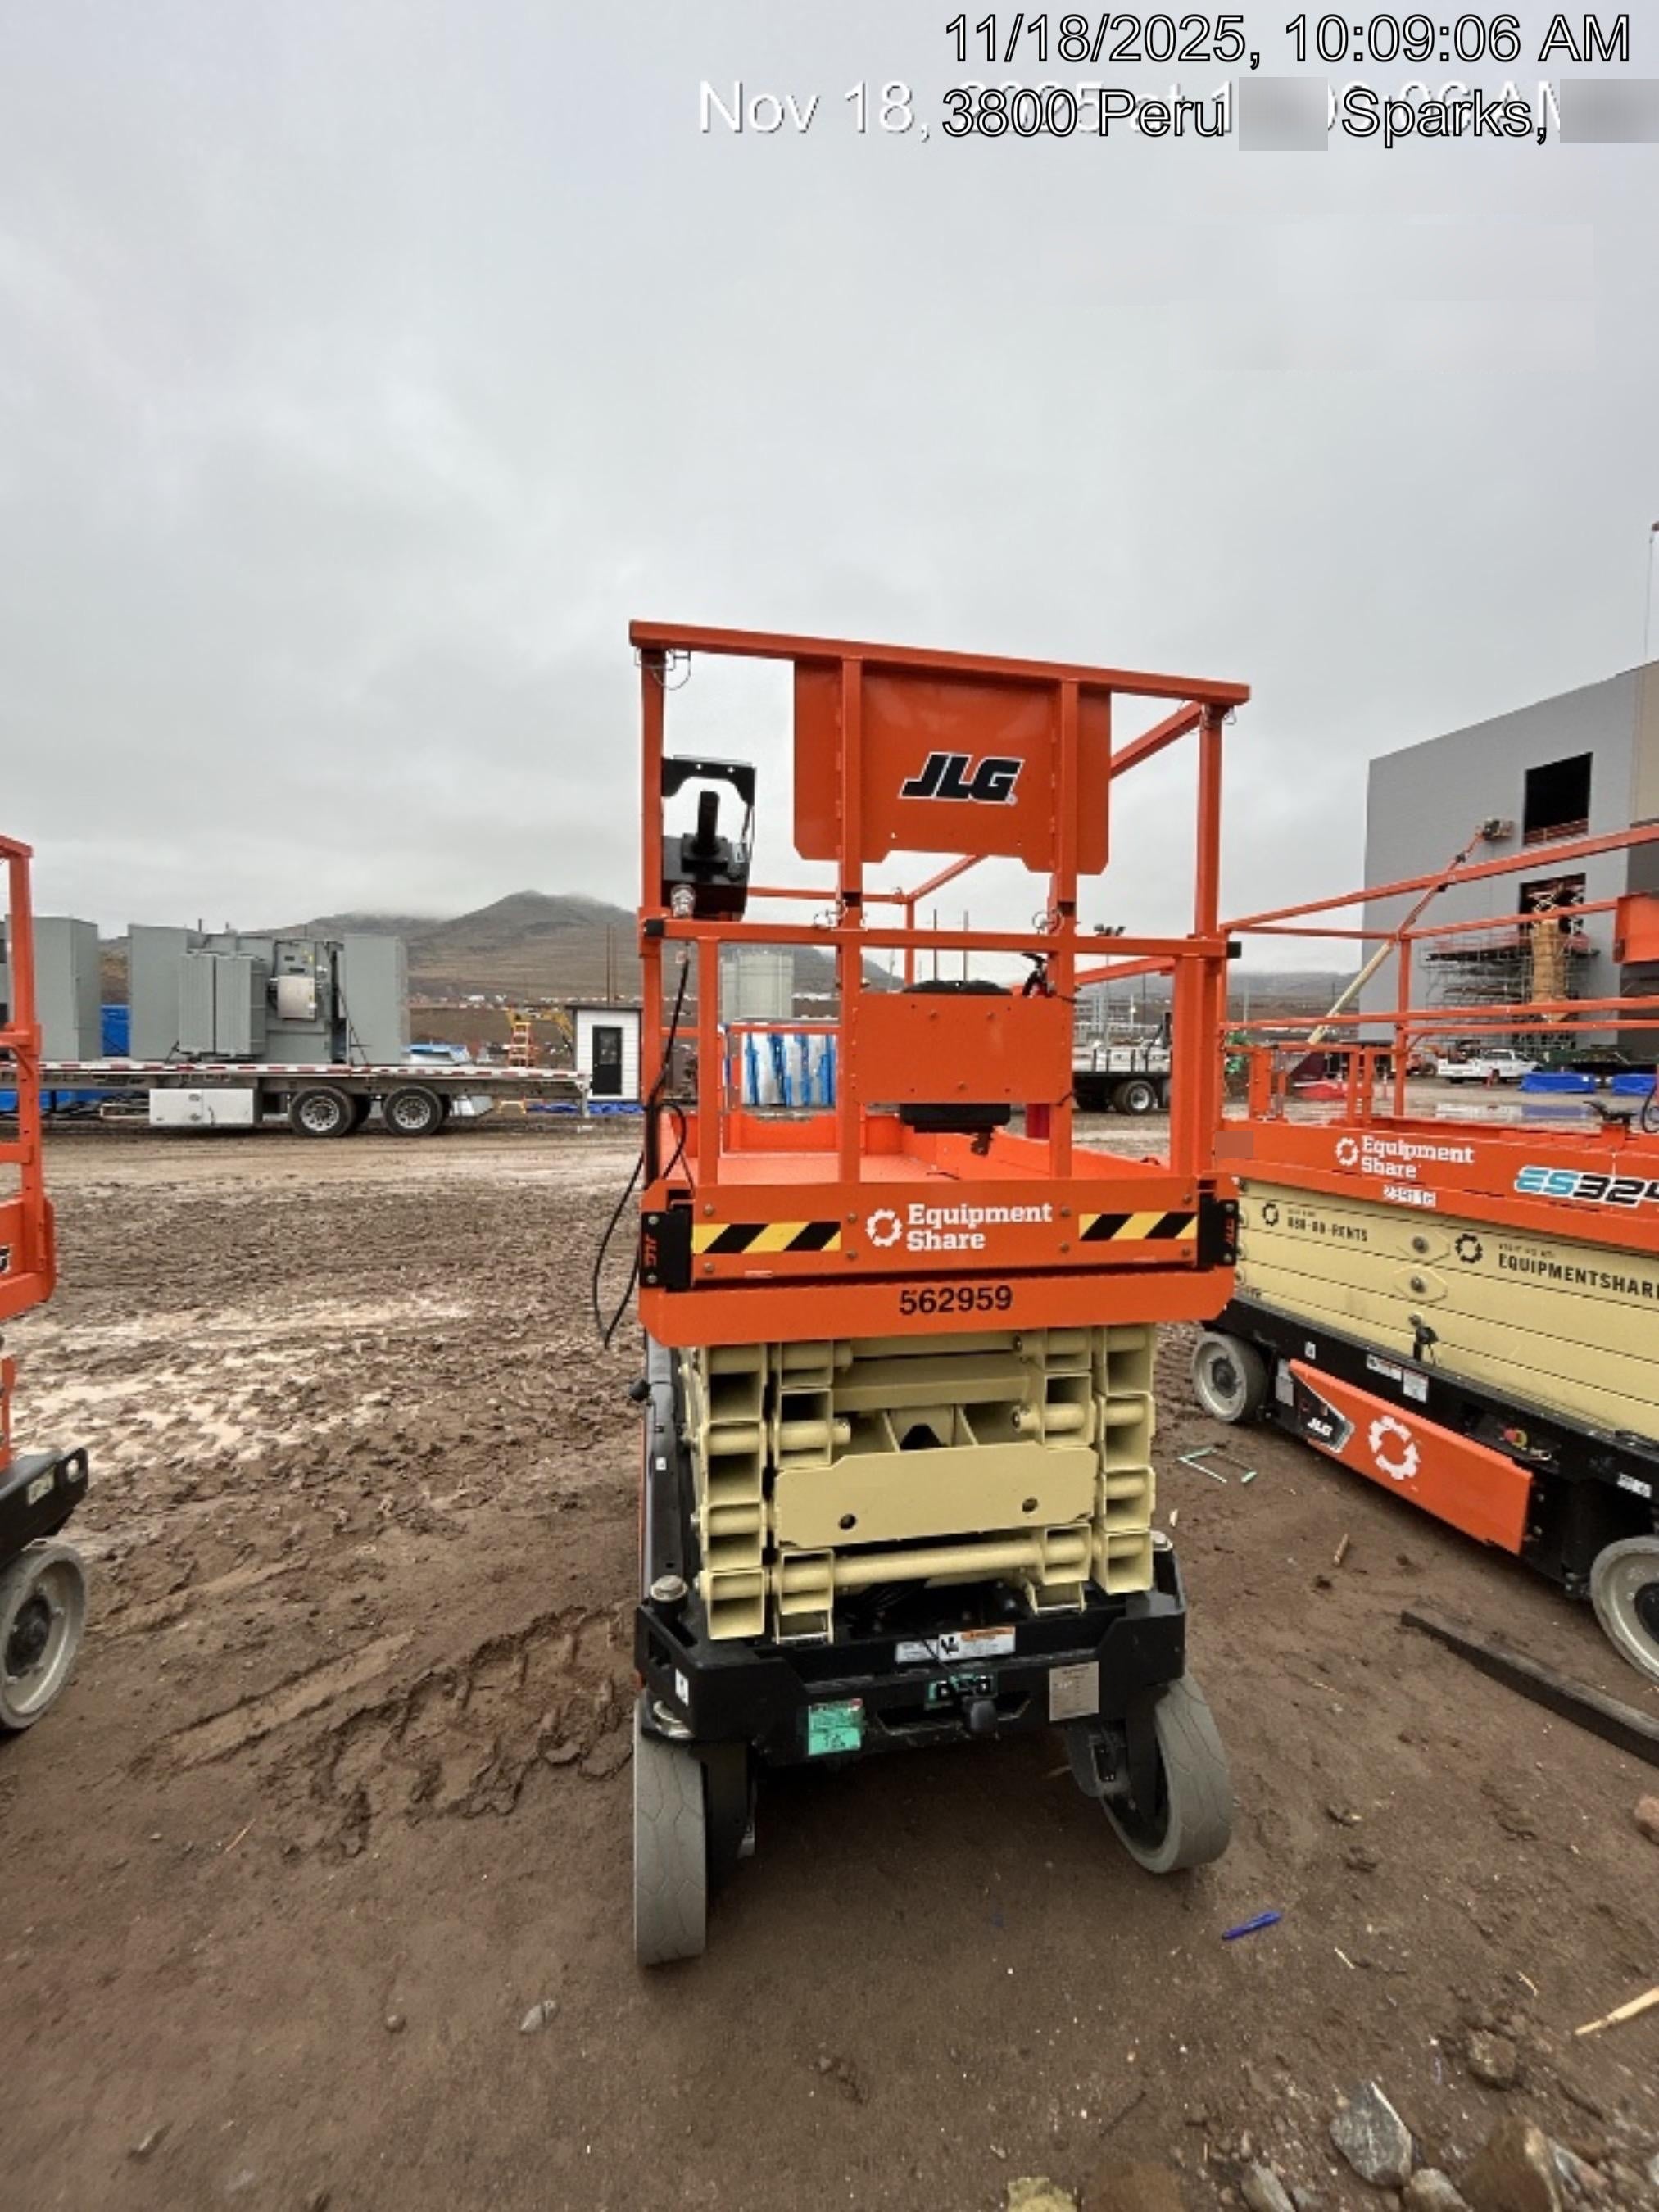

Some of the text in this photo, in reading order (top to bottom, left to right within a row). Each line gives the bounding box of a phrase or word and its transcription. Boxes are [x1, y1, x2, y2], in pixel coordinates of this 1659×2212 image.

[899, 751, 1026, 805] JLG
[1361, 1135, 1475, 1164] Equipment
[1361, 1156, 1418, 1179] Share
[907, 1203, 1053, 1229] Equipment
[906, 1229, 986, 1252] Share
[1499, 1253, 1659, 1299] EQUIPMENTSHAR
[900, 1285, 1013, 1316] 562959
